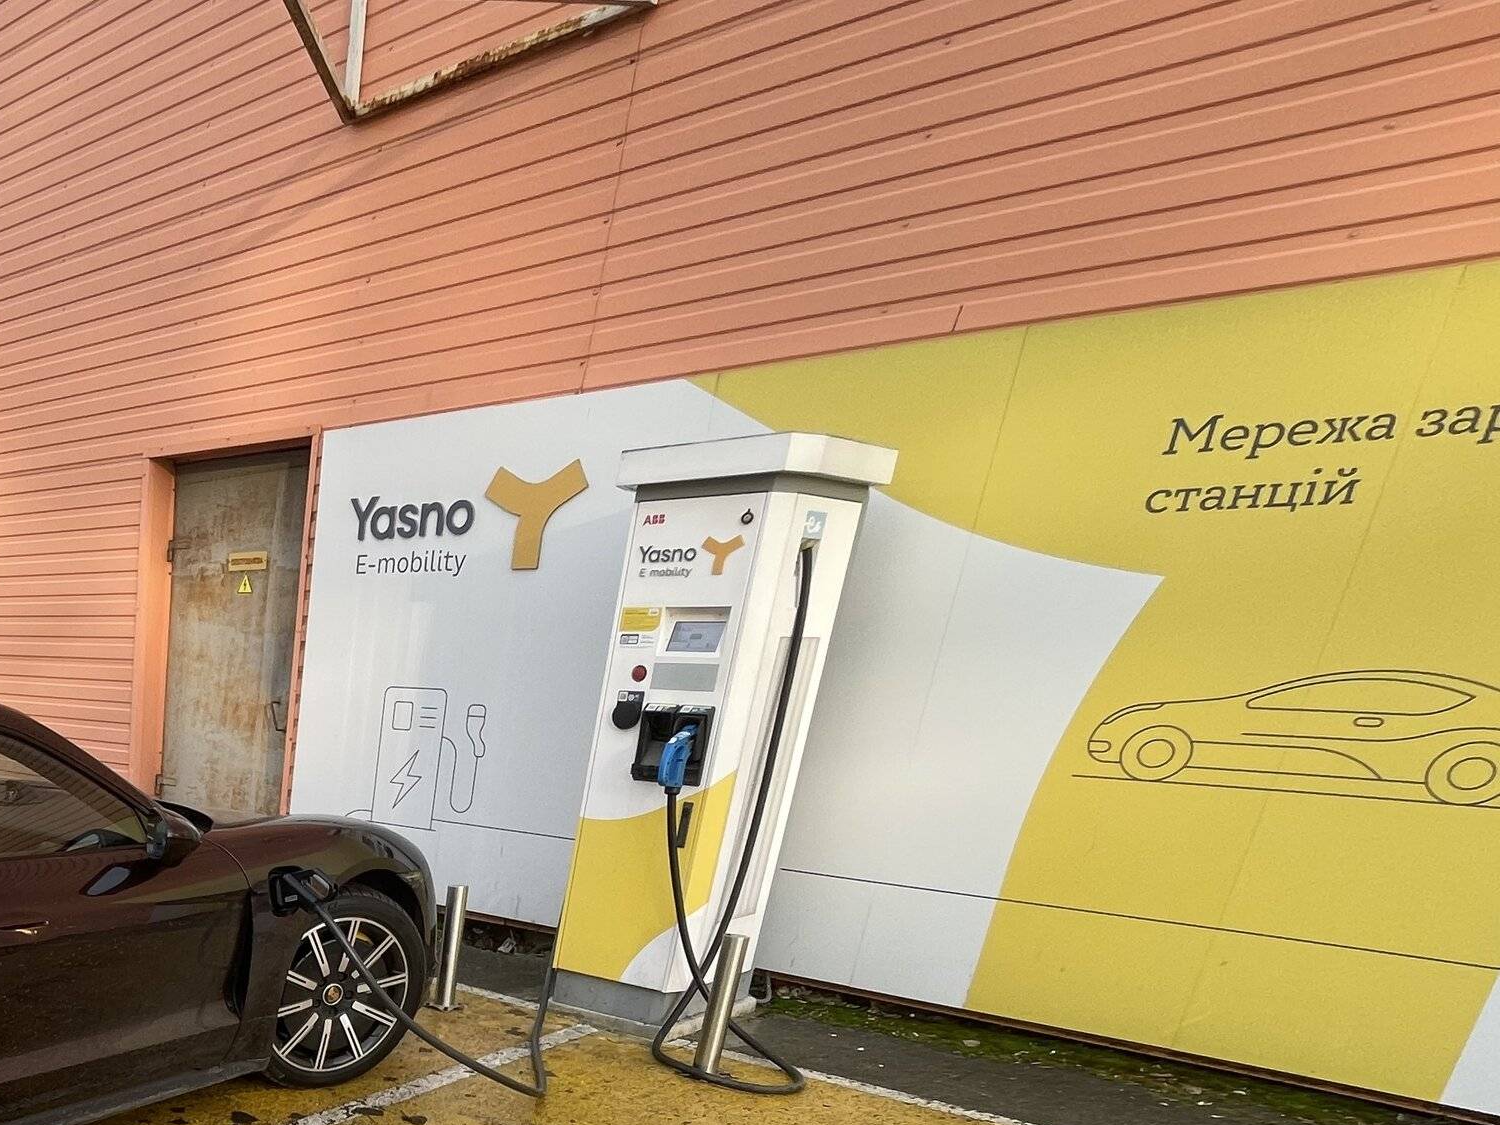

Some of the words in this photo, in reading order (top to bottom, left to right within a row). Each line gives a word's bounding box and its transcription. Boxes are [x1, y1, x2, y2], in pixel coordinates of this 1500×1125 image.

[1161, 413, 1397, 459] Мережа
[1144, 467, 1362, 514] станцій
[350, 495, 476, 541] Yasno
[643, 514, 665, 525] ABB
[356, 549, 467, 577] E-mobility
[640, 545, 697, 563] Yasno
